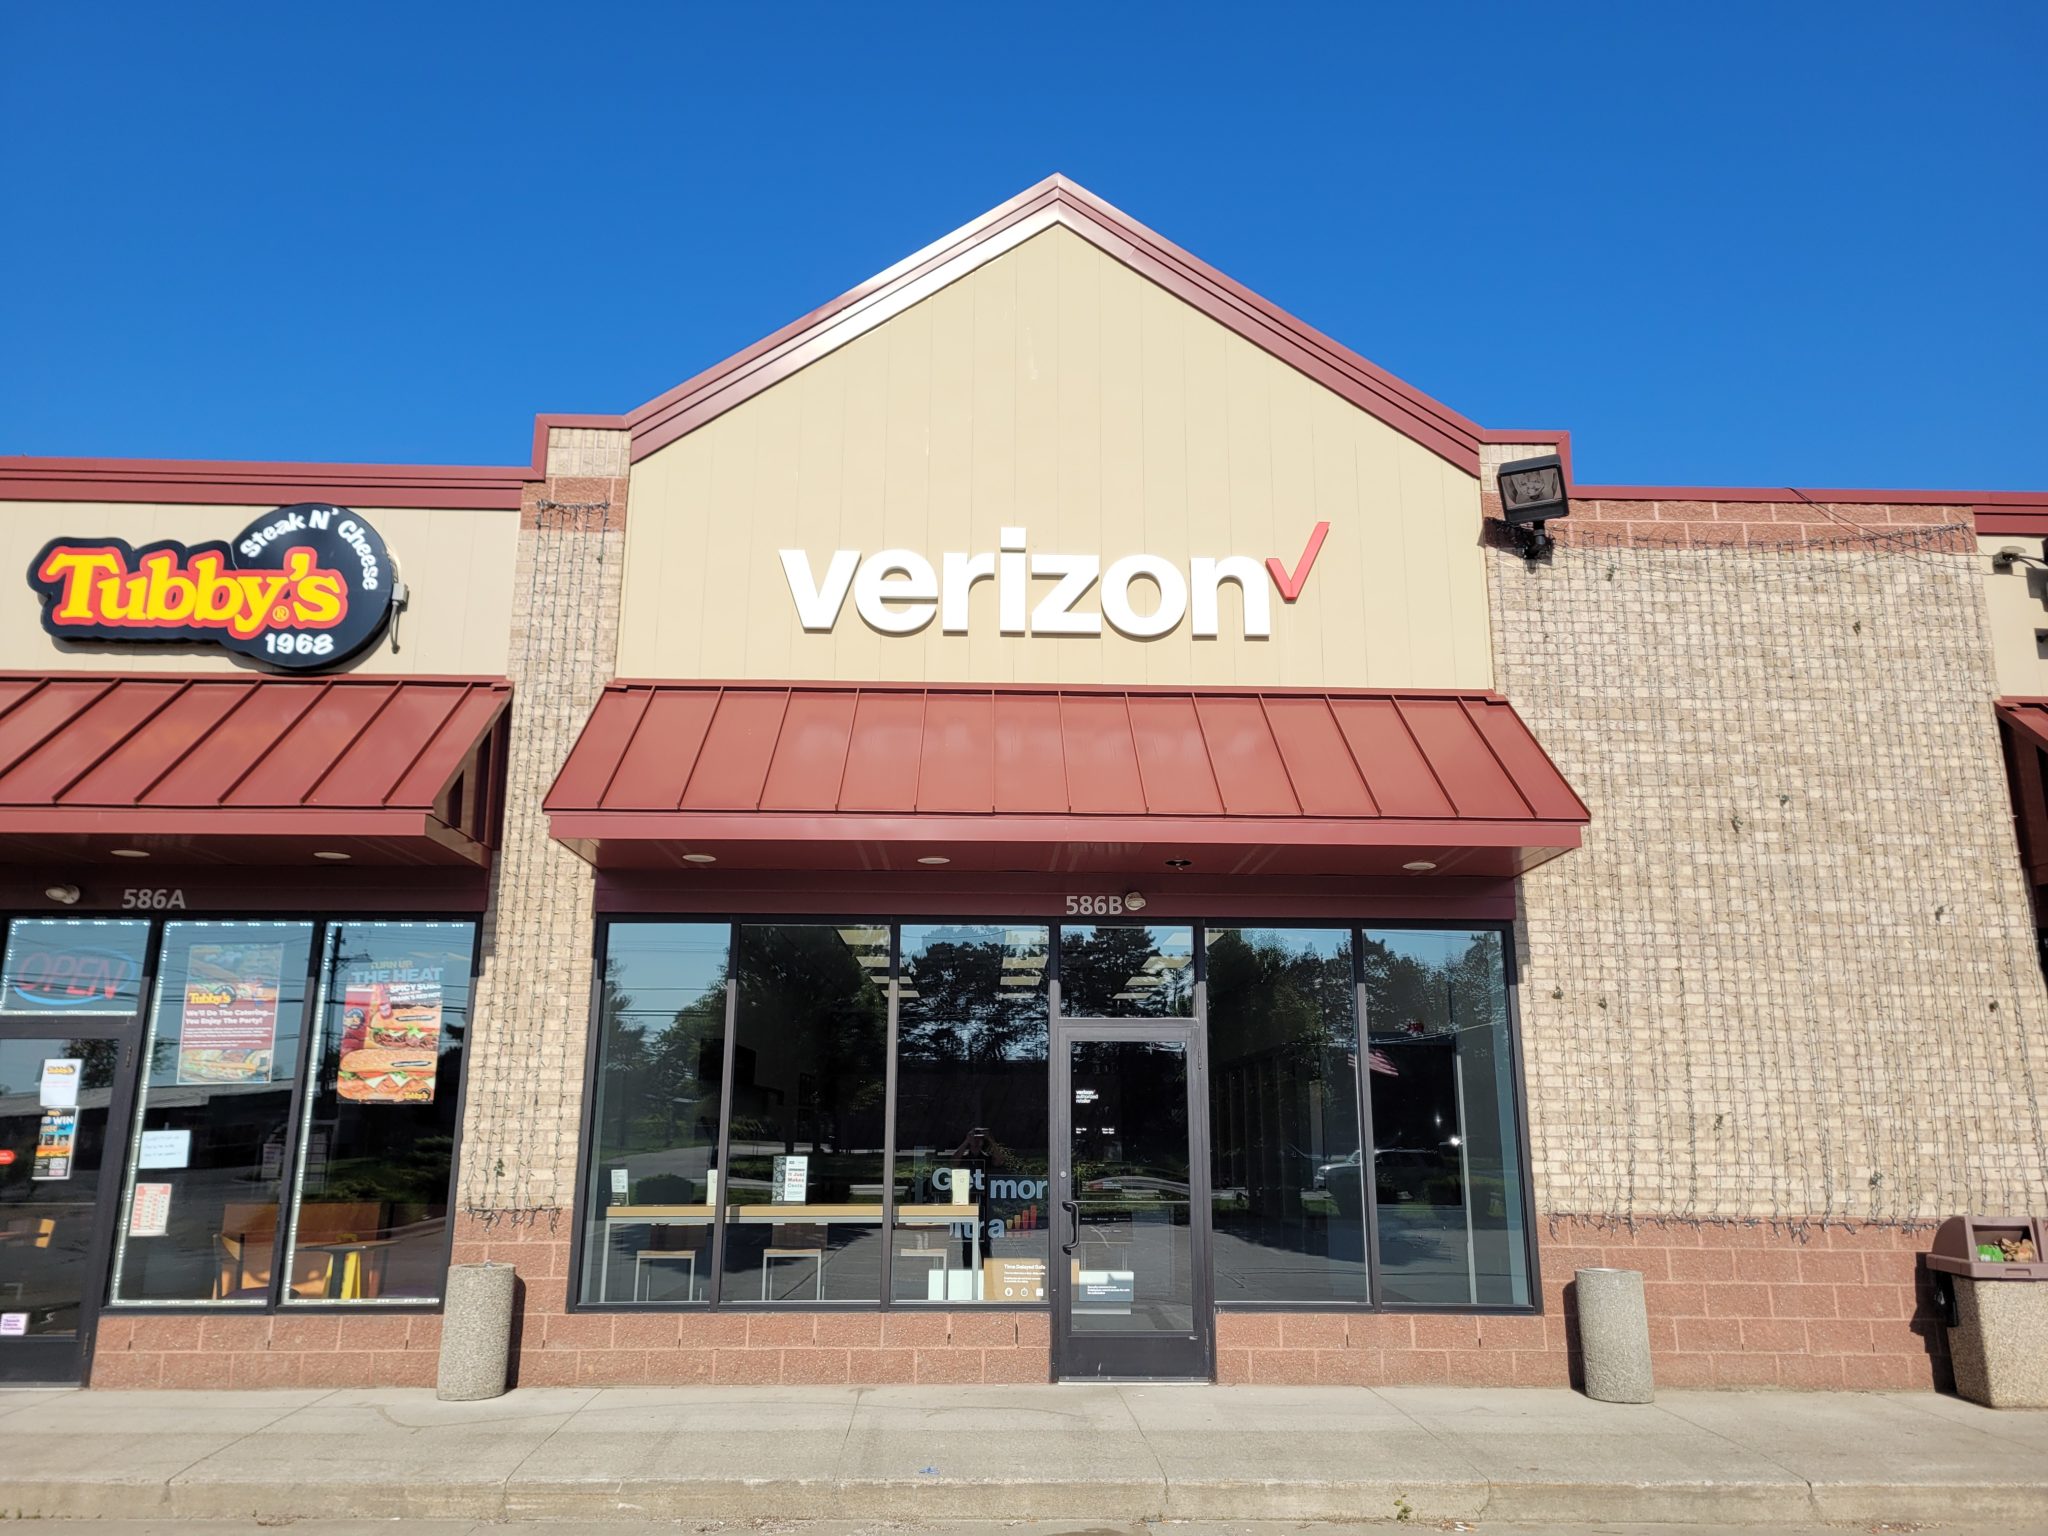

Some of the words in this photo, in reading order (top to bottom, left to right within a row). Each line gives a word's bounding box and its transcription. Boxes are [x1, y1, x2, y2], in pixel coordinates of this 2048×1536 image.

[240, 512, 307, 558] Steak
[338, 520, 379, 590] Cheese
[46, 552, 341, 632] Tubby's
[779, 527, 1271, 641] verizon
[265, 633, 334, 655] 1968
[122, 889, 186, 909] 586A
[1066, 895, 1123, 915] 586B
[16, 953, 127, 999] OPEN
[351, 970, 390, 984] THE
[393, 967, 444, 983] HEAT
[389, 984, 416, 993] SPICY
[52, 1115, 75, 1125] WIN
[932, 1167, 985, 1191] Gt
[989, 1179, 1049, 1200] mor
